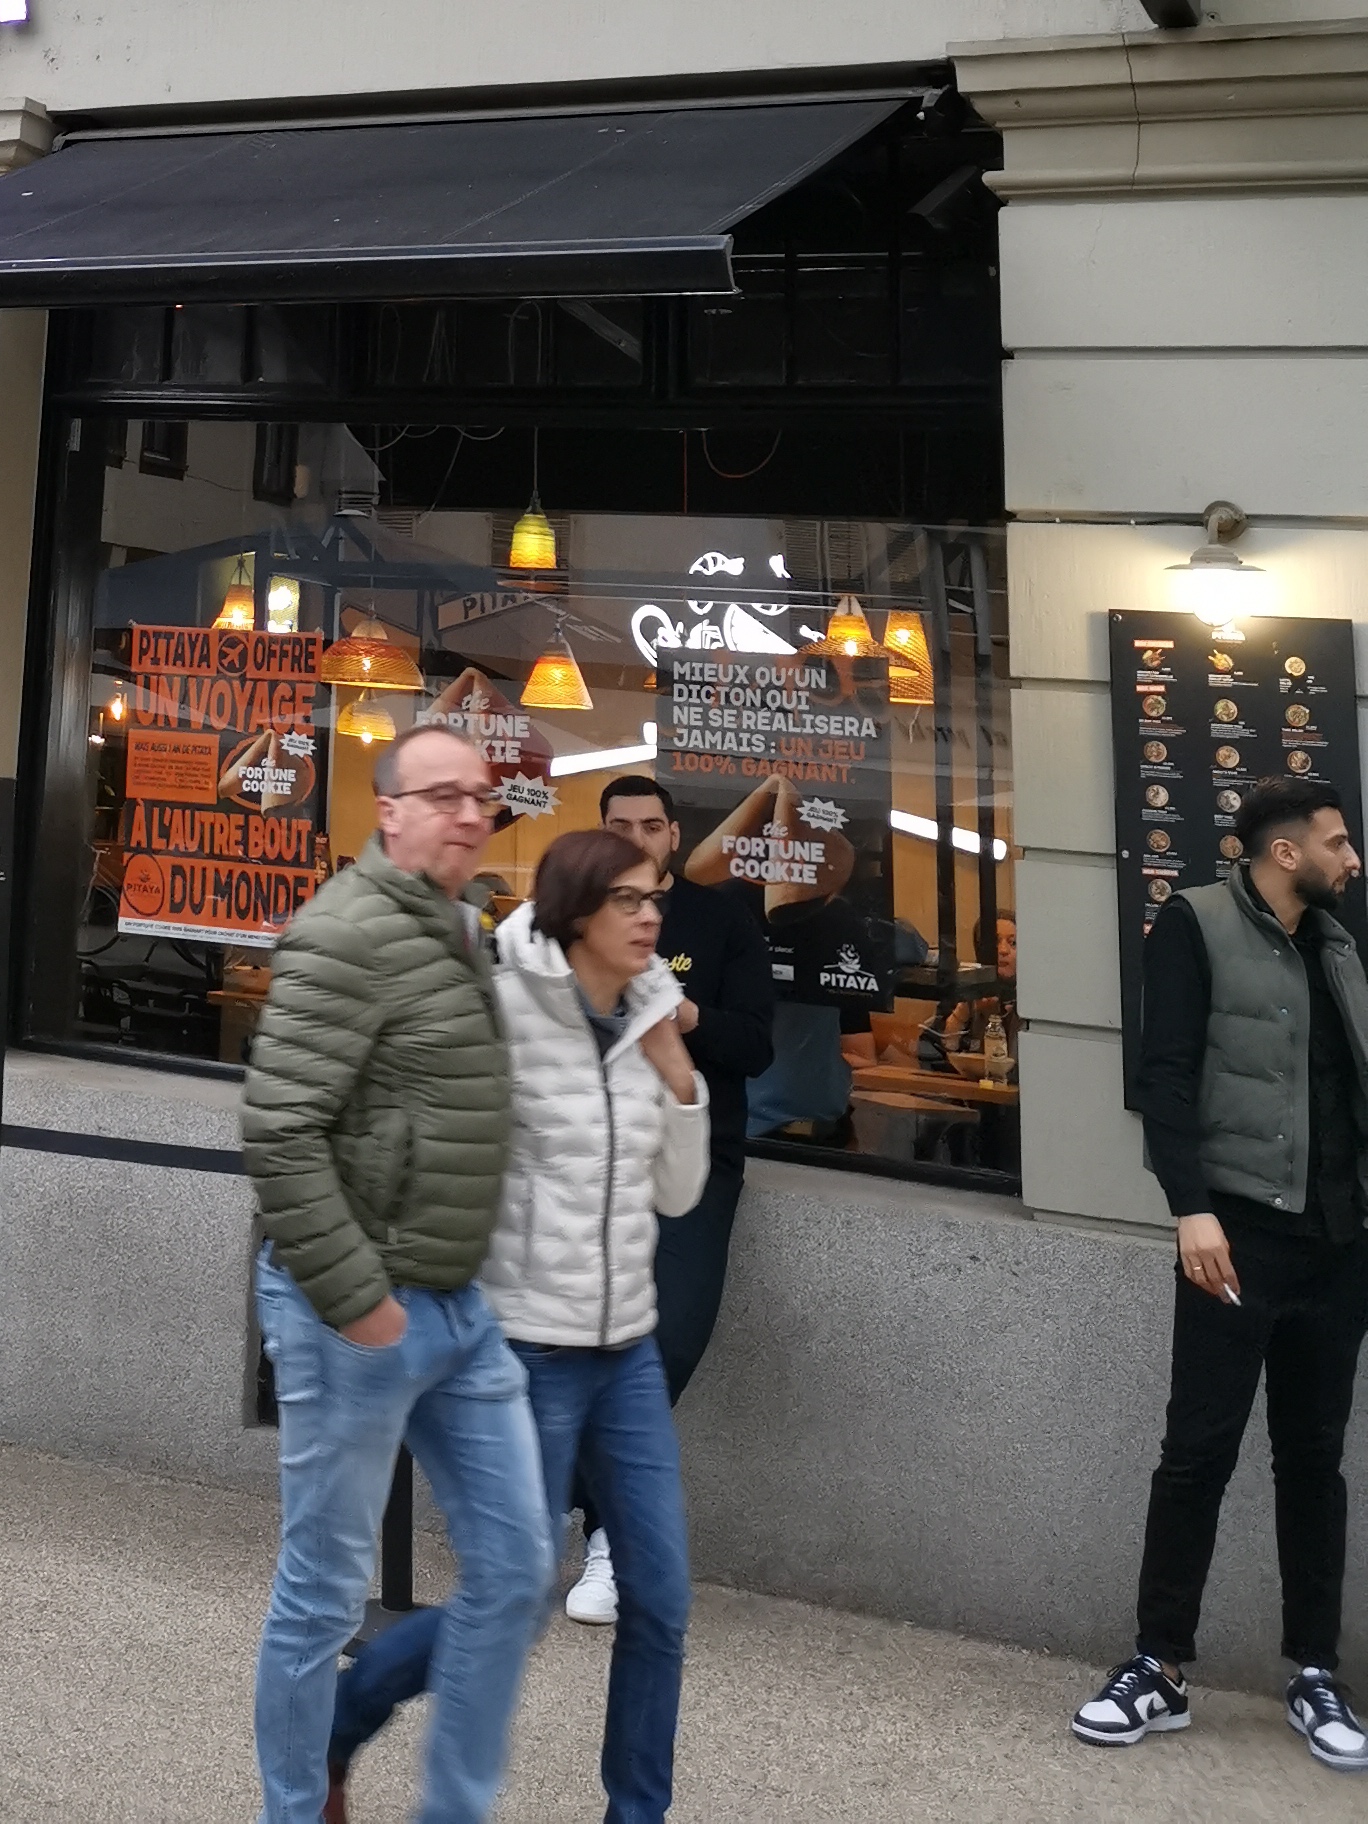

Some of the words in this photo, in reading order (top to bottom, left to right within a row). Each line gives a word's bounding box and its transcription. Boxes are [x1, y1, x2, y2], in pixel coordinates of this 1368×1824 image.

[138, 628, 211, 669] PITAYA
[253, 635, 317, 674] OFFRE
[673, 661, 750, 685] MIEUX
[755, 666, 827, 689] QU'UN
[136, 675, 180, 728] UN
[188, 676, 316, 737] VOYAGE
[673, 683, 762, 707] DICTON
[766, 690, 810, 711] QUI
[672, 706, 703, 726] NE
[708, 709, 737, 730] SE
[742, 707, 878, 738] RÉALISERA
[475, 740, 522, 764] KIE
[673, 728, 766, 753] JAMAIS
[779, 737, 813, 758] UN
[817, 739, 866, 761] JEU
[238, 767, 296, 782] FORTUNE
[671, 752, 736, 775] 100%
[741, 758, 856, 784] GAGNANT.
[241, 779, 292, 795] COOKIE
[505, 793, 549, 809] GAGNANT
[507, 784, 524, 795] JEU
[527, 787, 550, 800] 100%
[130, 798, 148, 849] À
[151, 806, 246, 858] L'AUTRE
[247, 815, 313, 863] BOUT
[762, 821, 789, 838] the
[721, 835, 825, 863] FORTUNE
[729, 859, 818, 885] COOKIE
[126, 882, 161, 895] PITAYA
[169, 864, 207, 916] DU
[212, 867, 308, 925] MONDE
[819, 972, 880, 991] PITAYA
